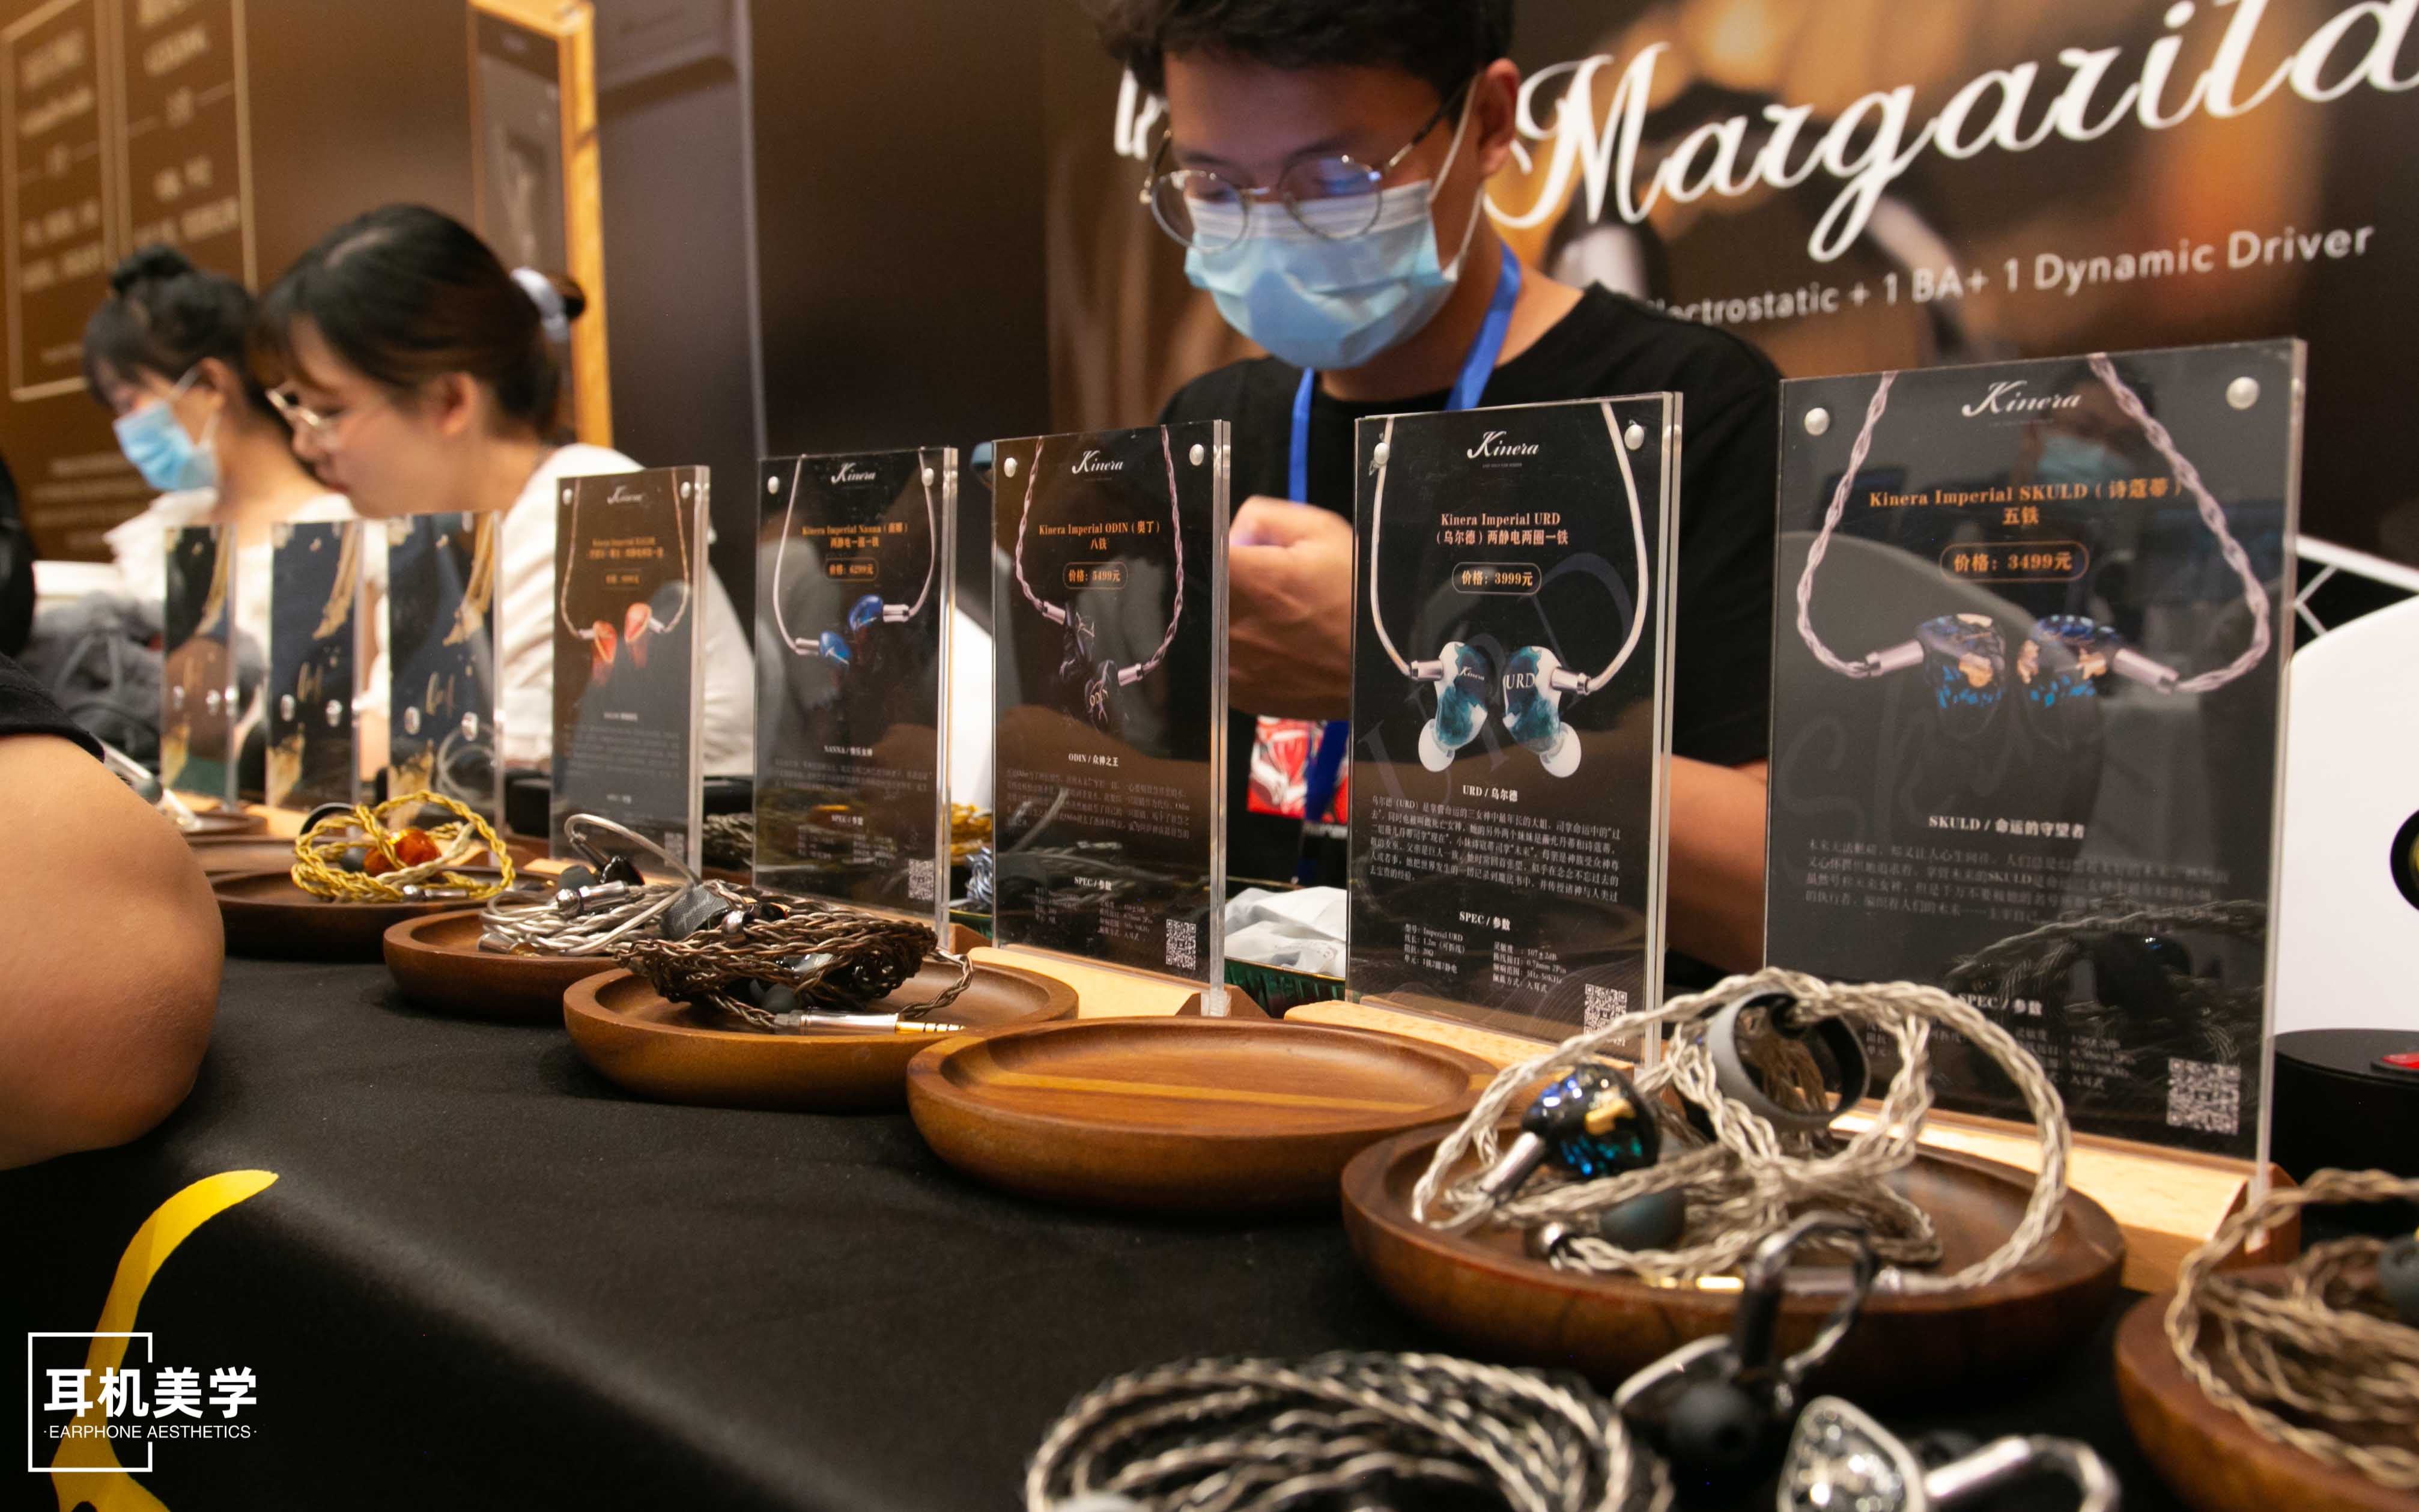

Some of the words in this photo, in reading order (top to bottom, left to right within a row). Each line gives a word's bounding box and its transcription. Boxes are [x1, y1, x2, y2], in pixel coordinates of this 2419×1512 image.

[1885, 275, 1898, 305] 1
[2005, 259, 2017, 292] 1
[2033, 238, 2214, 299] Dynamic
[2227, 227, 2375, 272] Driver
[1962, 380, 2081, 417] Kinera
[1466, 430, 1540, 459] Kinera
[1072, 449, 1124, 475] Kinera
[831, 463, 876, 485] Kinera
[1870, 491, 1928, 508] Kinera
[1934, 486, 2013, 508] Imperial
[2019, 482, 2088, 502] SKULD
[1441, 513, 1477, 526] Kinera
[1481, 512, 1530, 528] Imperial
[1534, 512, 1561, 526] URD
[2002, 507, 2039, 526] 五铁
[1039, 524, 1066, 536] Kinera
[1067, 523, 1103, 536] Imperial
[1105, 521, 1129, 534] ODIN
[1506, 672, 1536, 690] URD
[1463, 785, 1483, 796] URD
[1491, 787, 1519, 803] 乌尔德
[1928, 815, 1980, 831] SKULD
[1459, 910, 1485, 924] SPEC
[1493, 916, 1511, 932] 参数
